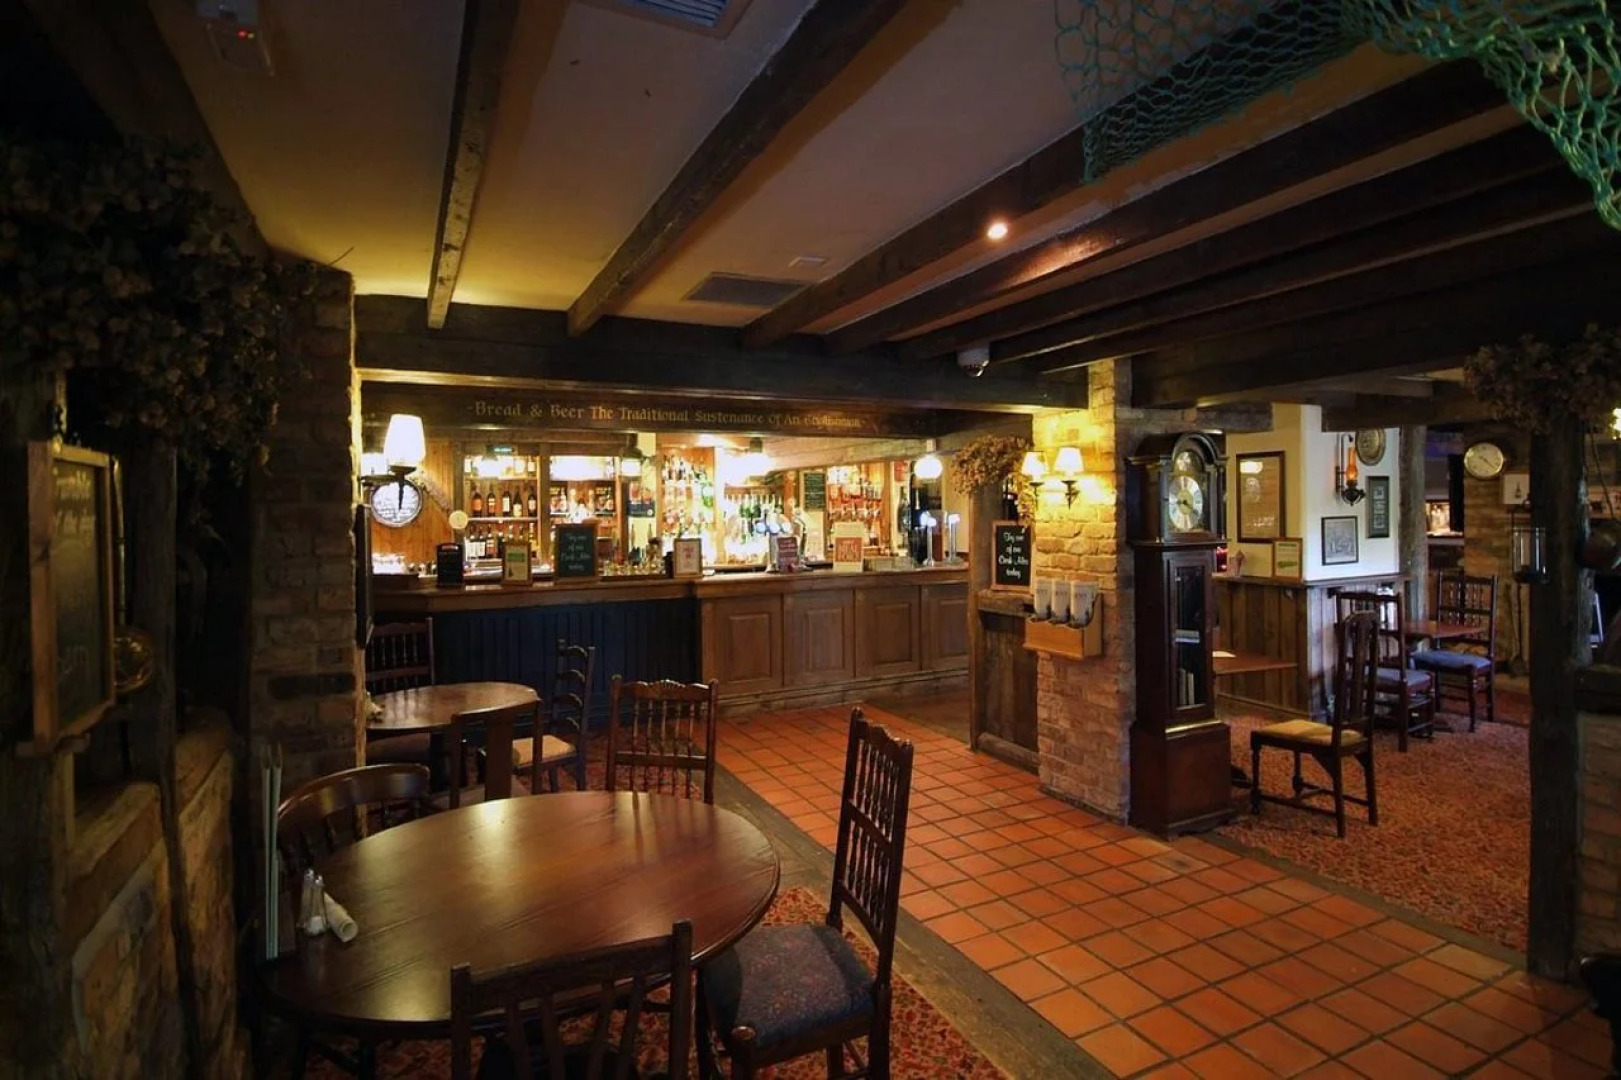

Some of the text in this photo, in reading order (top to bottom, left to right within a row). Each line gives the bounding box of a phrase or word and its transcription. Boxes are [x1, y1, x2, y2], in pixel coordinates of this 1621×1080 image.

[529, 404, 543, 418] &
[550, 404, 585, 420] Beer
[589, 405, 614, 420] The
[617, 407, 689, 422] Traditional
[694, 409, 764, 425] Sustenance
[784, 412, 801, 426] An
